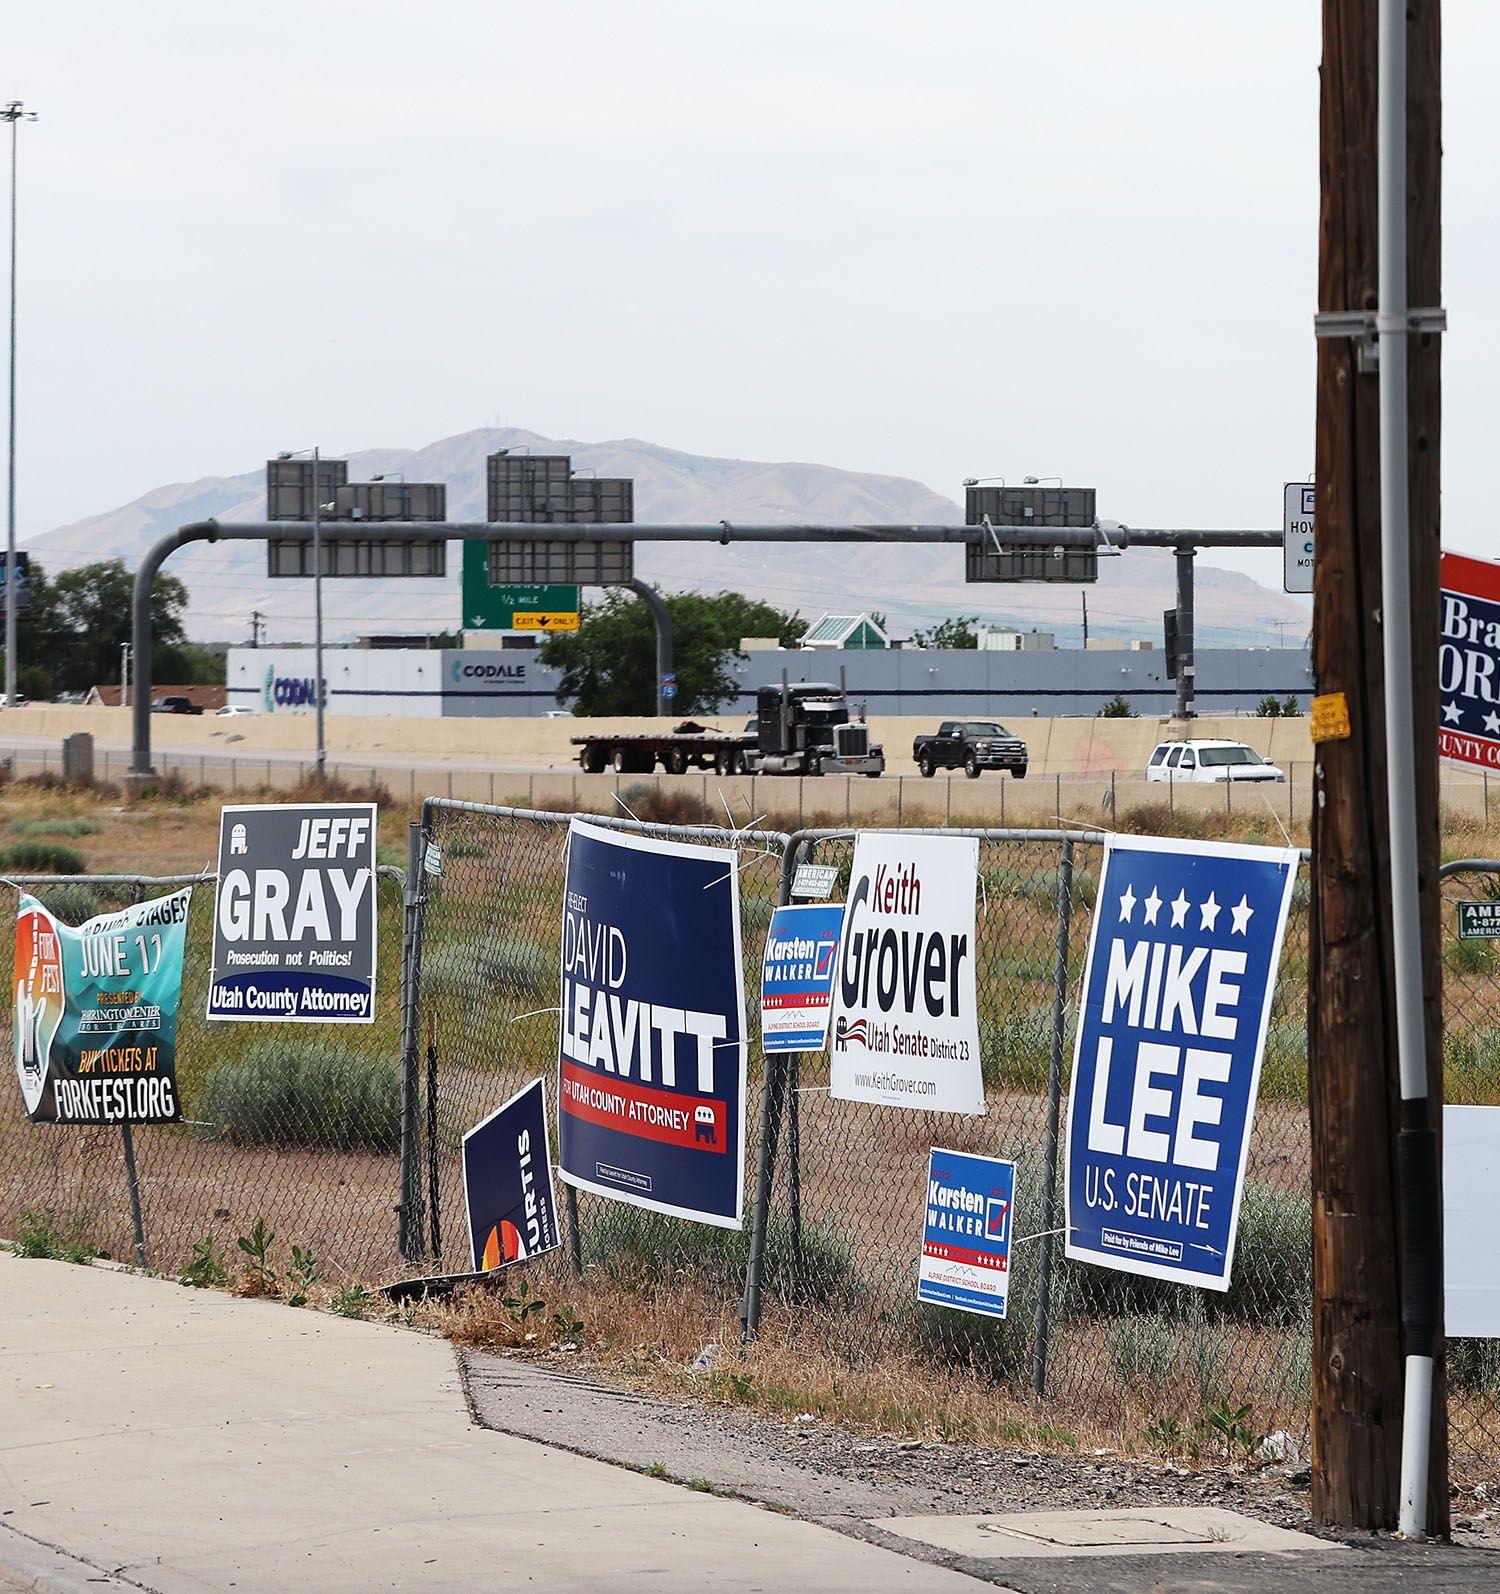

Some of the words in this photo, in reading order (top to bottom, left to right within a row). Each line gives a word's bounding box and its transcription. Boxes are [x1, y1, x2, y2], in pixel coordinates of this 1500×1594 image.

[516, 617, 534, 625] EXIT
[553, 617, 575, 625] ONLY
[463, 665, 526, 678] CODALE
[1439, 734, 1484, 760] UNTY
[291, 818, 370, 860] JEFF
[219, 868, 373, 942] GRAY
[872, 862, 921, 916] Keith
[81, 935, 131, 978] JUNE
[226, 950, 279, 966] Prosecution
[285, 952, 303, 966] not
[309, 950, 353, 967] Politics!
[565, 911, 627, 989] DAVID
[766, 936, 815, 962] Karsten
[841, 875, 968, 1018] Grover
[765, 963, 813, 982] WALKER
[1101, 937, 1248, 1040] MIKE
[212, 985, 243, 1009] Utah
[246, 985, 299, 1014] County
[301, 987, 370, 1016] Attorney
[562, 976, 727, 1094] LEAVITT
[868, 1021, 890, 1053] Utah
[892, 1024, 929, 1057] Senate
[930, 1037, 958, 1060] District
[959, 1040, 970, 1061] 23
[100, 1047, 143, 1073] TICKETS
[144, 1047, 158, 1072] AT
[53, 1076, 175, 1119] FORKFEST.ORG
[854, 1071, 937, 1095] www.KeithGrover.com
[571, 1080, 590, 1106] UTAH
[590, 1088, 627, 1117] COUNTY
[628, 1099, 690, 1131] ATTORNEY
[1087, 1035, 1233, 1172] LEE
[928, 1179, 985, 1216] Karsten
[1085, 1164, 1119, 1212] U.S.
[1123, 1171, 1215, 1230] SENATE
[927, 1208, 984, 1237] WALKER
[1129, 1237, 1149, 1250] Friends
[1155, 1241, 1169, 1254] Mike
[1169, 1246, 1180, 1257] Lee
[928, 1271, 943, 1281] ALPINE
[943, 1274, 962, 1285] DISTRICT
[962, 1278, 980, 1289] SCHOOL
[979, 1282, 997, 1292] BOARD
